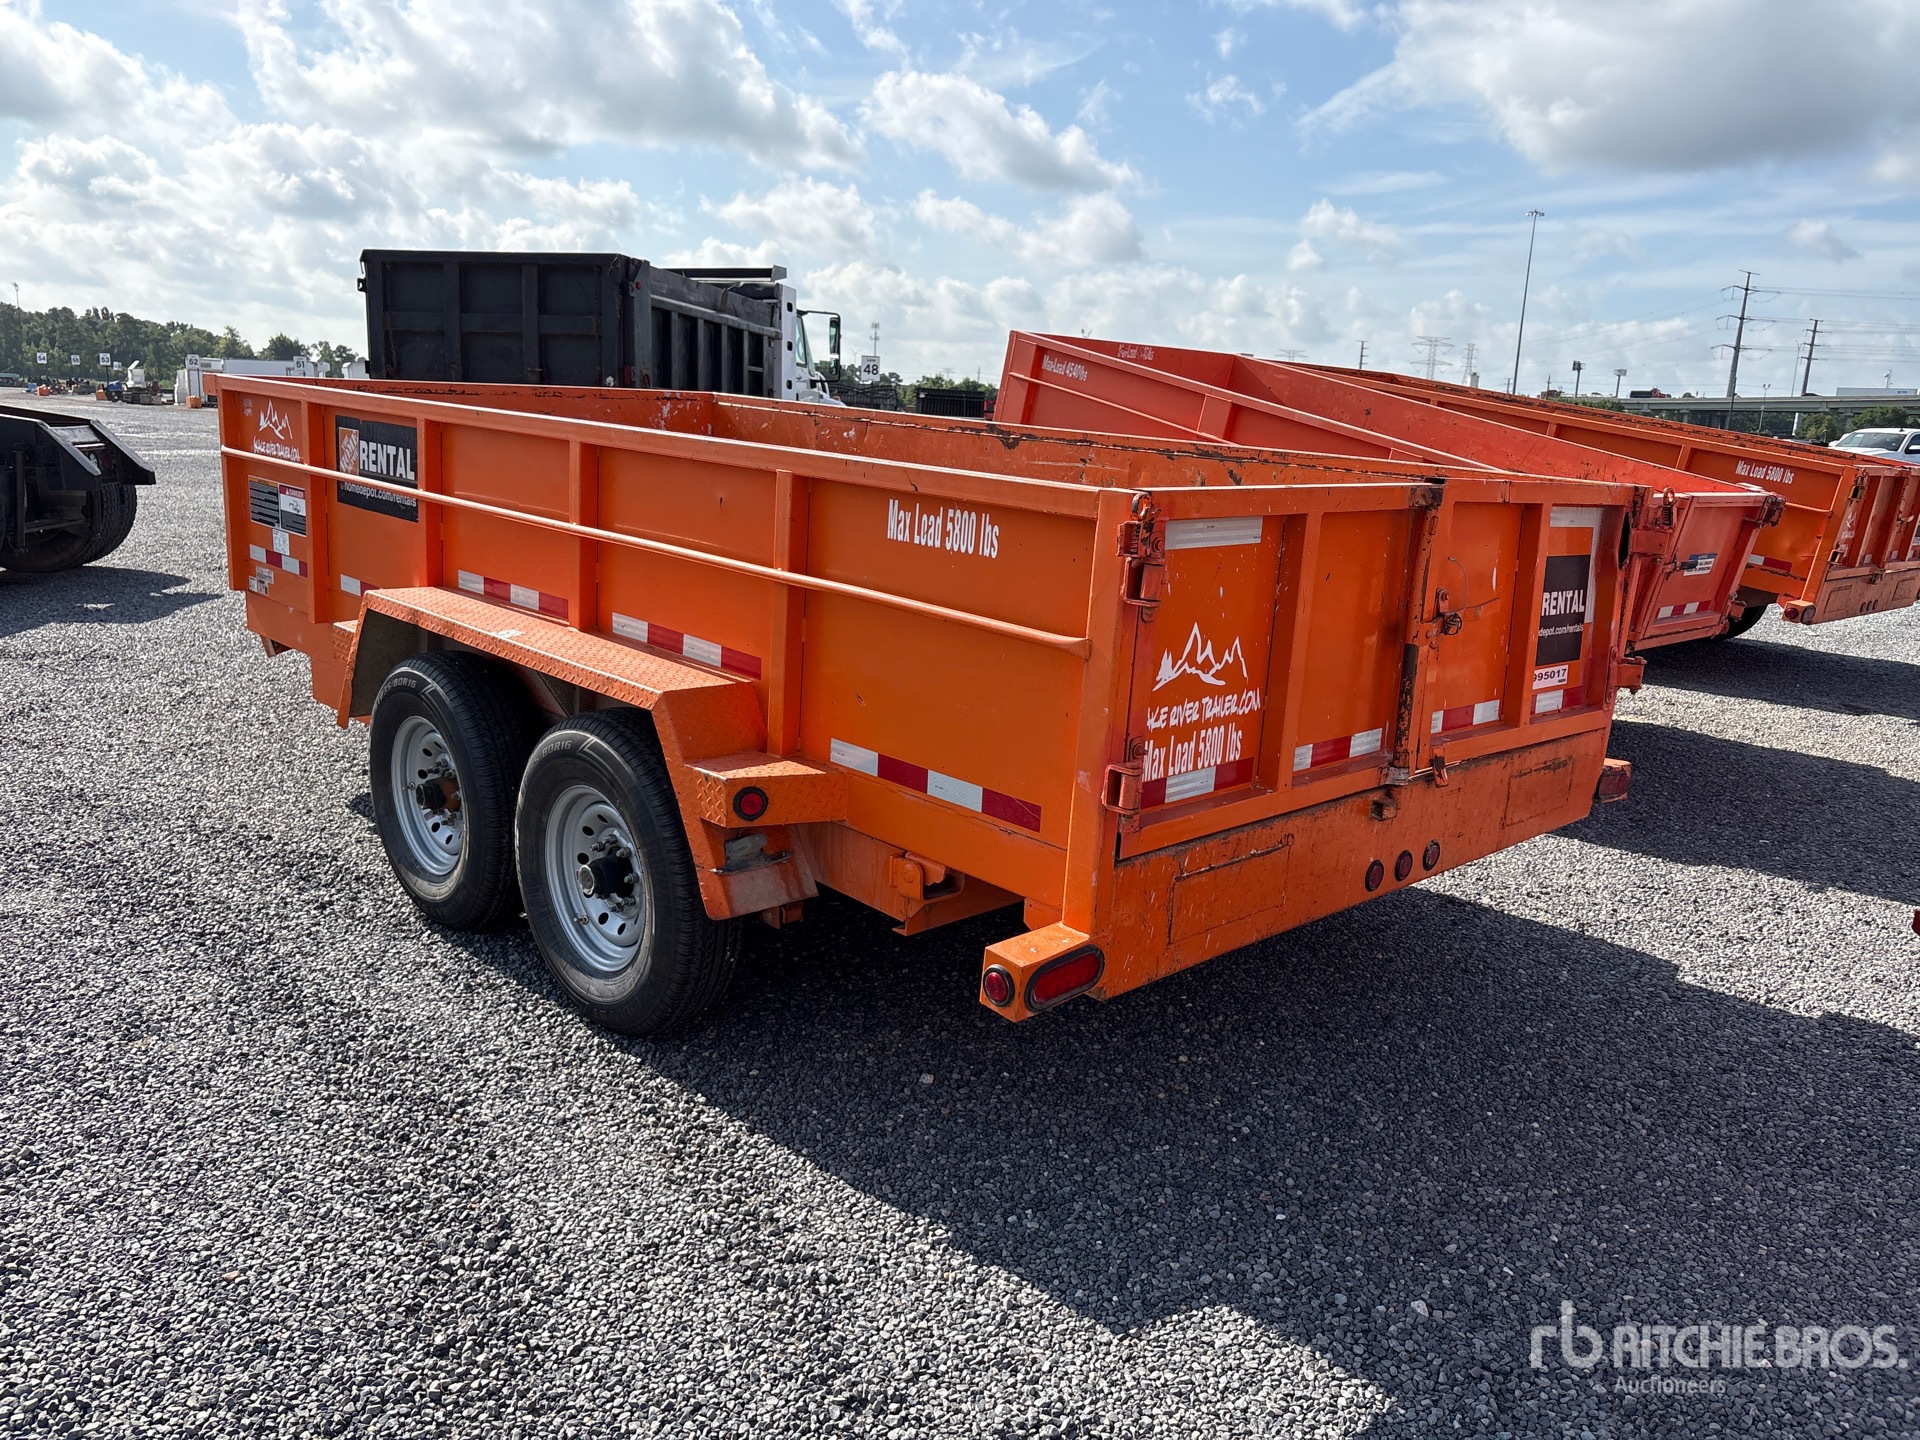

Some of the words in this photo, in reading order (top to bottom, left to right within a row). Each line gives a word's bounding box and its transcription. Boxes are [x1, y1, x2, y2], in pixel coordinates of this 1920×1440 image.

[188, 358, 199, 366] 52
[295, 360, 305, 369] 51
[863, 363, 879, 375] 48
[360, 439, 416, 480] RENTAL
[1735, 459, 1750, 476] Max
[1750, 462, 1768, 479] Load
[1766, 465, 1784, 482] 5800
[1783, 468, 1795, 485] lbs
[887, 499, 911, 543] Max
[914, 502, 943, 548] Load
[945, 508, 977, 555] 5800
[979, 513, 1000, 560] lbs
[1541, 589, 1585, 617] RENTAL
[1169, 698, 1200, 729] RIVER
[1202, 686, 1261, 723] TRAILER.COM
[1141, 739, 1166, 782] Max
[1168, 730, 1197, 776] Load
[1198, 724, 1225, 769] 5800
[1225, 721, 1243, 763] lbs
